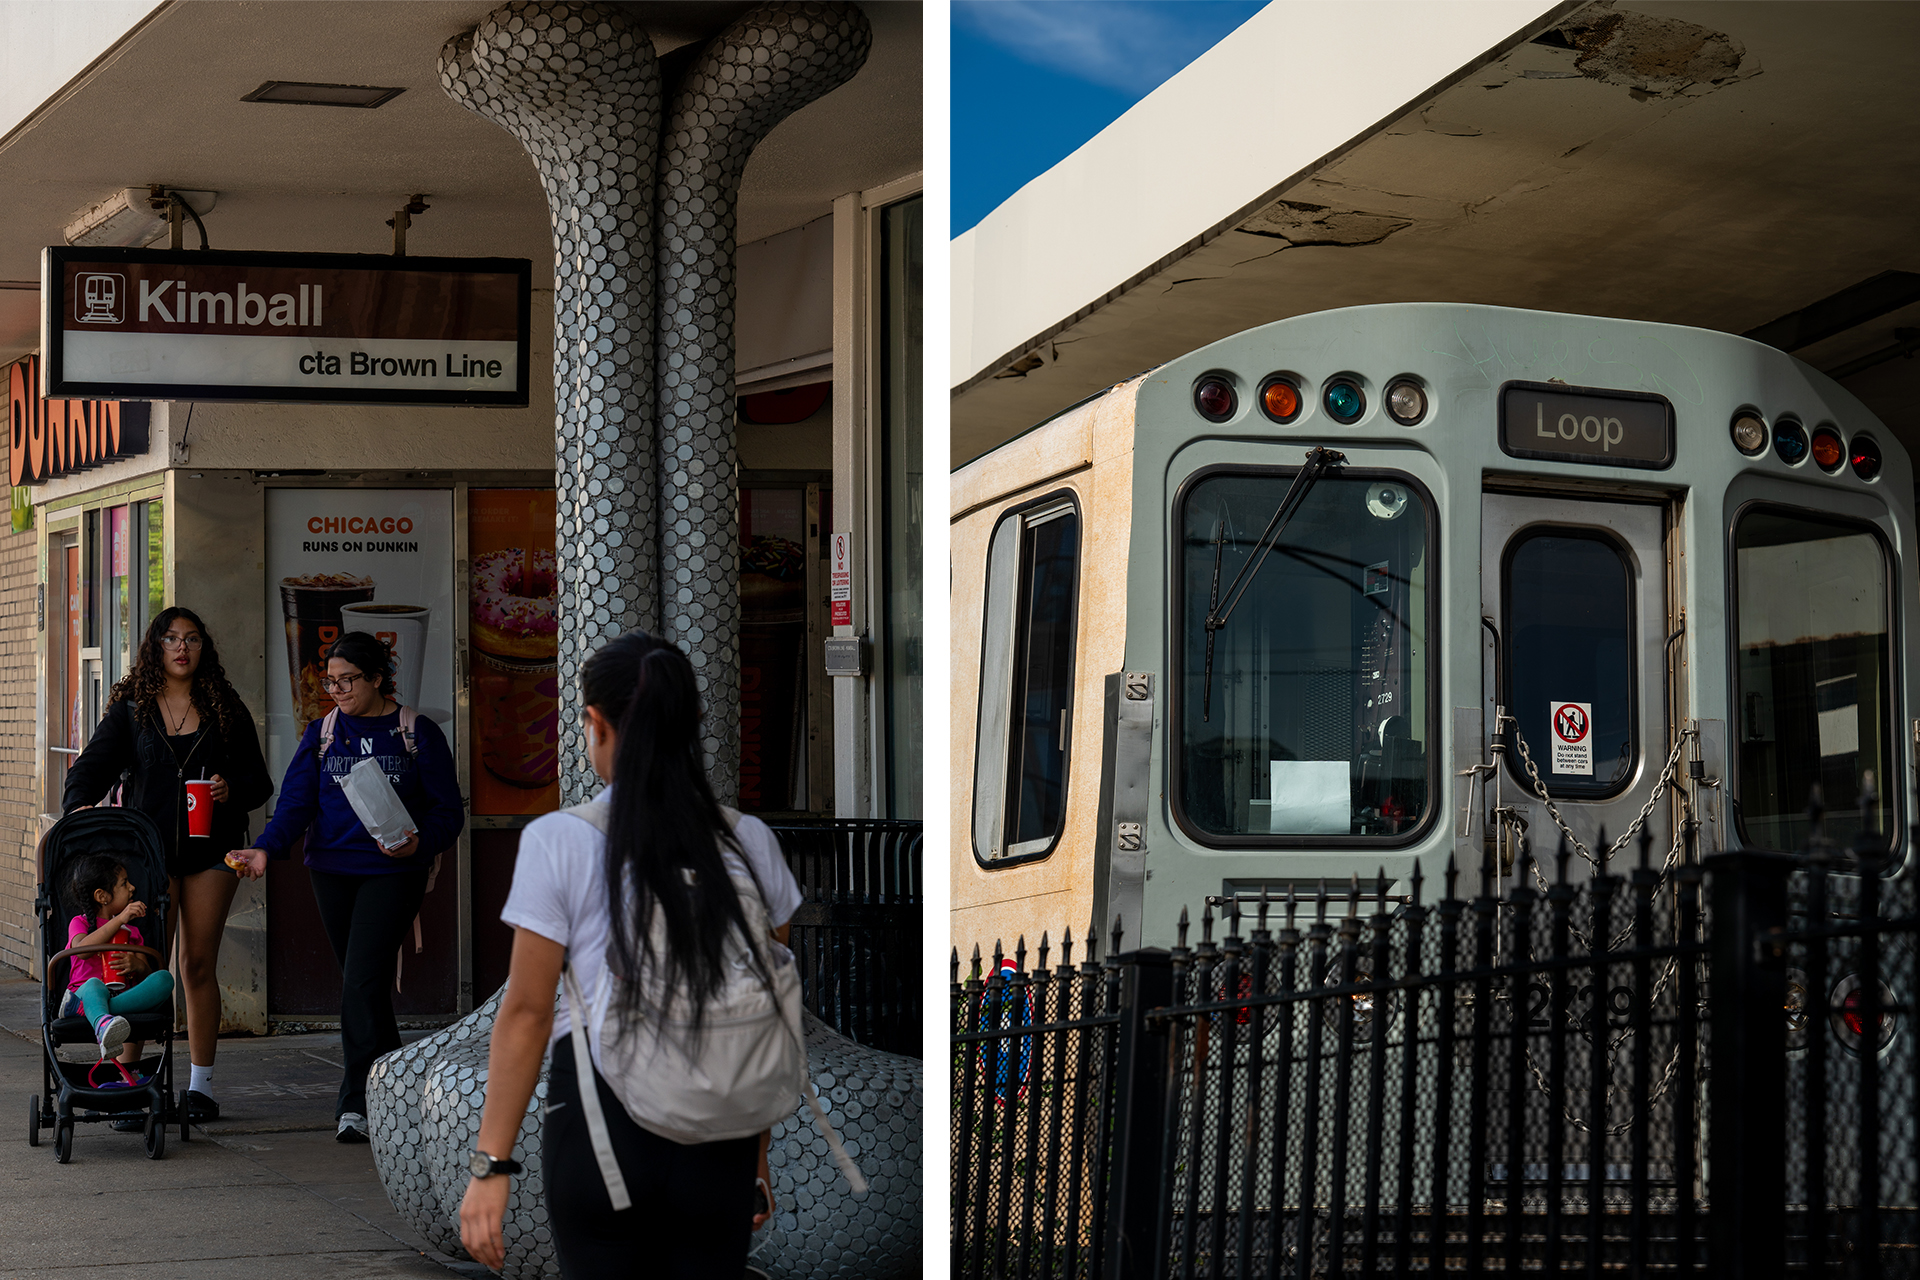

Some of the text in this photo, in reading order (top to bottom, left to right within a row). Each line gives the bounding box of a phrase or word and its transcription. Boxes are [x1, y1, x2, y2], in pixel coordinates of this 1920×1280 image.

[139, 279, 323, 327] Kimball
[298, 351, 502, 378] cta Brown Line
[1536, 402, 1624, 452] Loop
[307, 516, 414, 534] CHICAGO
[303, 541, 418, 553] RUNS ON DUNKIN
[1377, 691, 1394, 705] 2729
[360, 737, 373, 755] N
[322, 755, 412, 773] NORTHTERN
